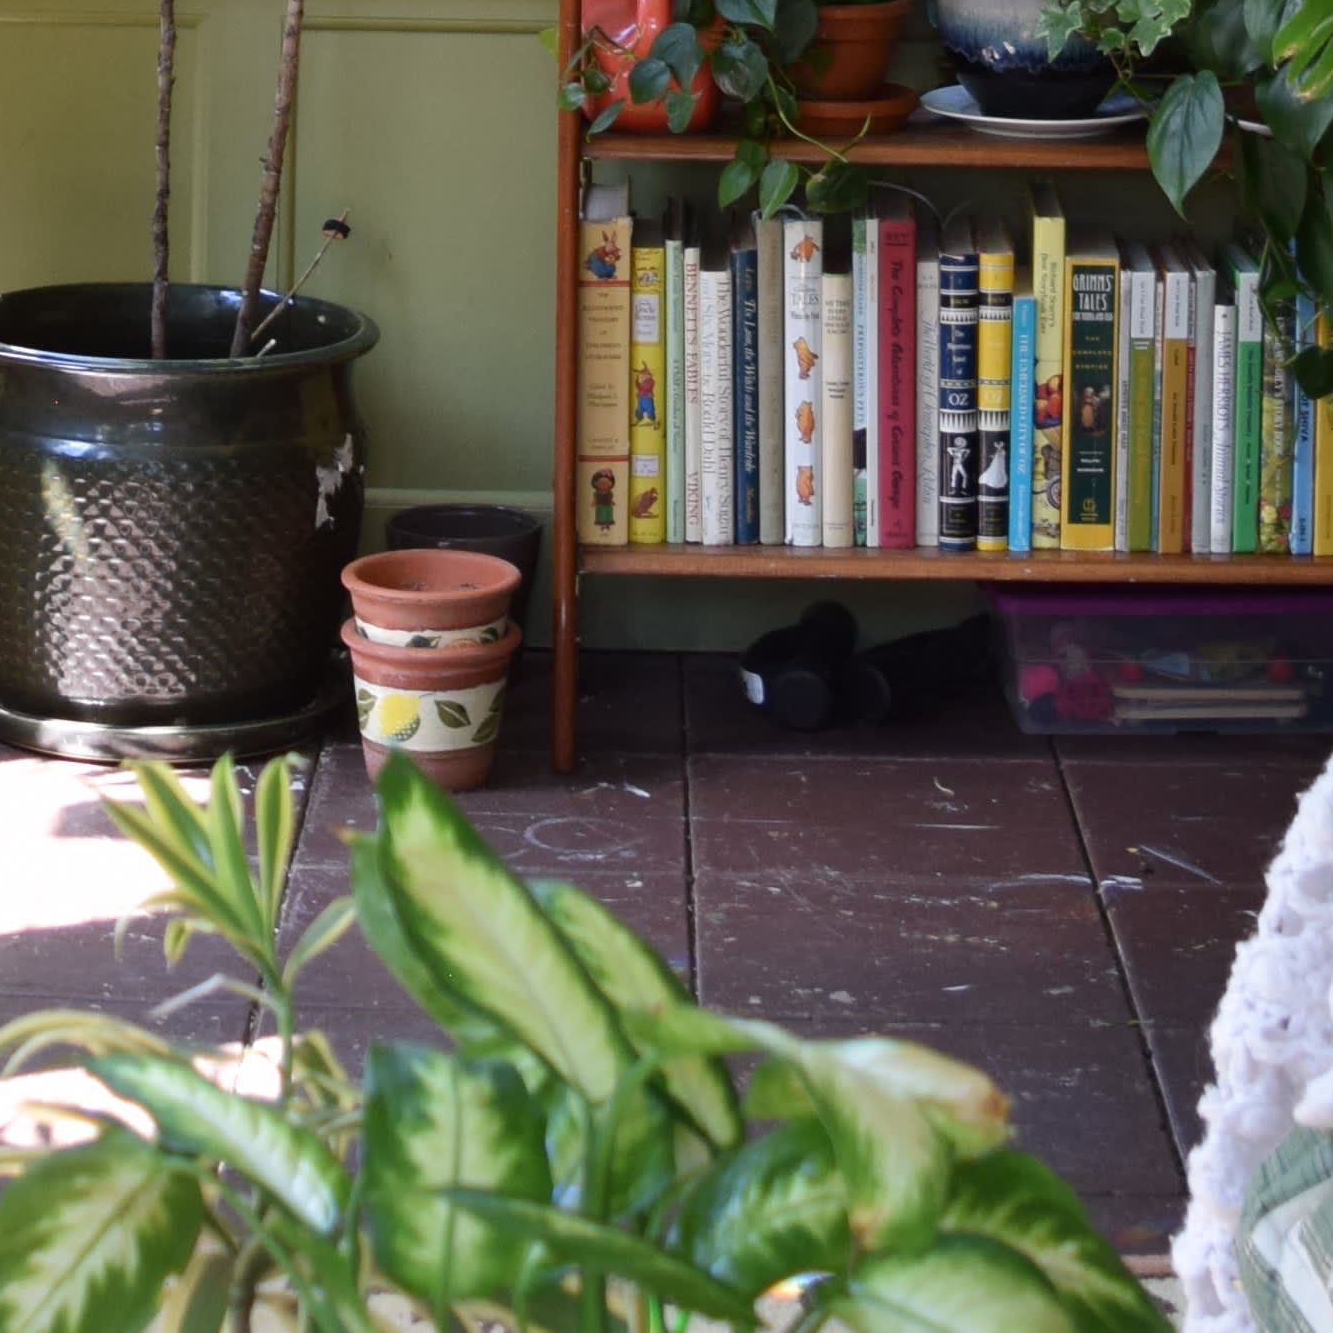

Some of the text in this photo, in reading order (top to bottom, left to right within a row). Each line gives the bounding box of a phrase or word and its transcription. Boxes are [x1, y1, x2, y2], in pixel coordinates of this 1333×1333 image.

[891, 260, 903, 281] The
[744, 298, 756, 317] The
[791, 293, 819, 305] TALES
[886, 285, 903, 337] Complete
[1078, 293, 1108, 311] TALES
[702, 304, 715, 331] Six
[1018, 334, 1028, 353] THE
[1217, 330, 1232, 368] JAMES
[686, 352, 698, 404] FABLES
[857, 324, 866, 424] PREPOSTEROUS PETS
[891, 342, 904, 407] Adventures
[1018, 358, 1028, 414] EMERALD
[703, 393, 715, 434] Roald
[715, 279, 732, 537] The Wonderful Story of Henry Sugar
[744, 394, 756, 414] and
[948, 392, 969, 406] OZ
[1274, 399, 1284, 428] STORY
[1017, 415, 1027, 441] CITY
[1274, 430, 1284, 456] BOOK
[1300, 410, 1309, 443] SHIVA
[703, 440, 715, 474] Dahl
[744, 428, 756, 474] Wardrobe
[891, 425, 904, 466] Curious
[1017, 442, 1027, 457] OF
[1016, 458, 1027, 475] OZ
[687, 470, 699, 525] VIKING
[887, 470, 904, 509] George
